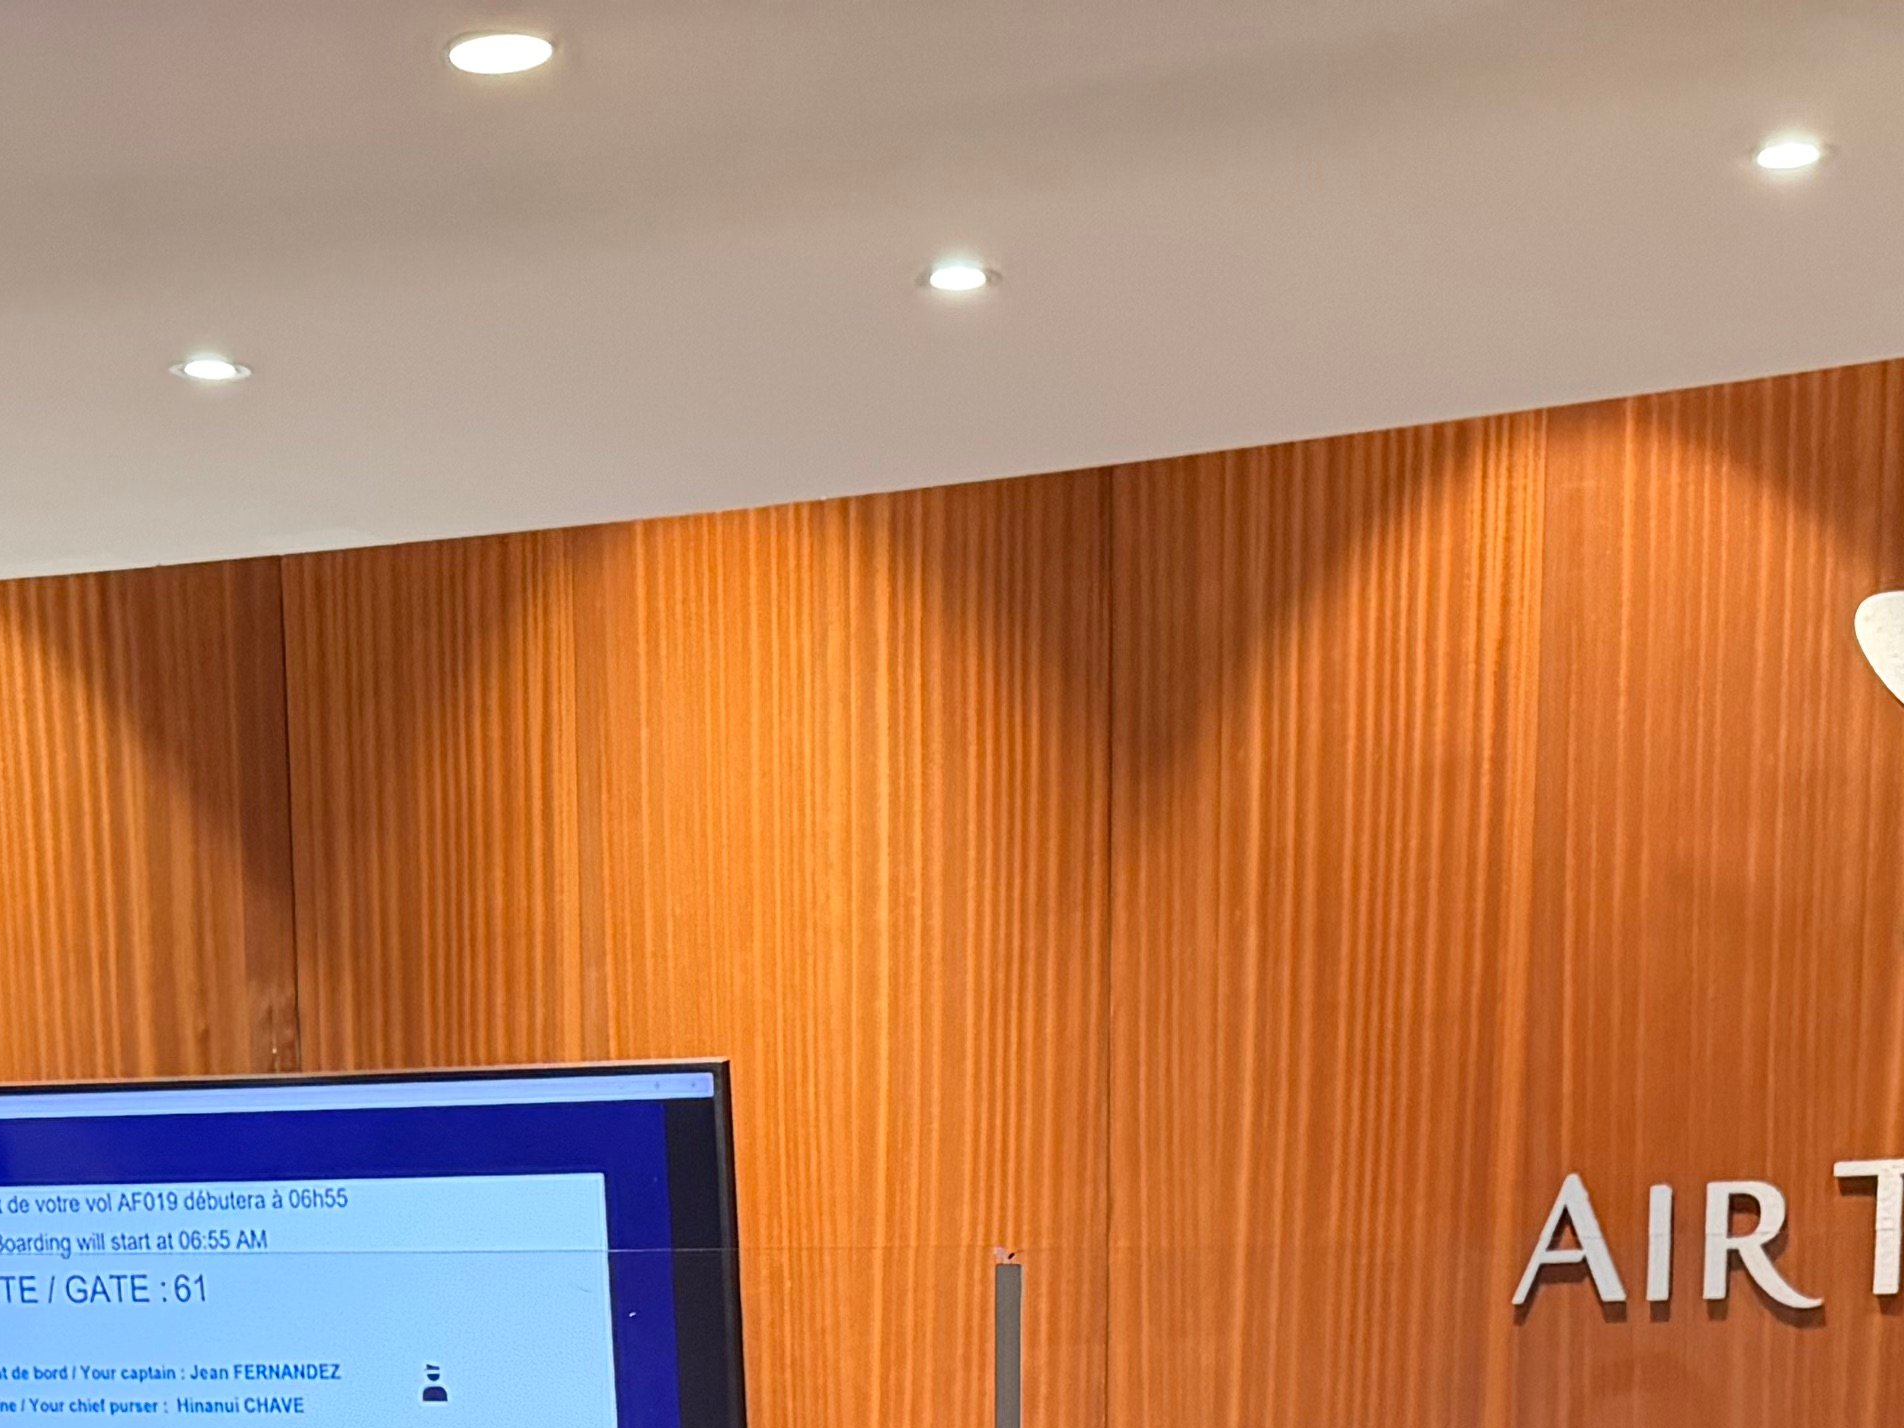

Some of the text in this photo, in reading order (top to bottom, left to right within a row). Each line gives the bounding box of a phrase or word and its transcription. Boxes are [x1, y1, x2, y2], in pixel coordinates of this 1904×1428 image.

[7, 1195, 30, 1215] de
[35, 1195, 80, 1214] votre
[86, 1194, 113, 1213] vol
[117, 1191, 177, 1212] AF019
[184, 1189, 265, 1211] débutera
[273, 1189, 284, 1210] à
[290, 1188, 348, 1209] 06h55
[77, 1232, 105, 1252] will
[111, 1233, 151, 1251] start
[156, 1233, 173, 1250] at
[179, 1230, 229, 1250] 06:55
[236, 1229, 268, 1250] AM
[1511, 1170, 1824, 1310] AIR
[48, 1275, 56, 1304] /
[65, 1274, 150, 1303] GATE
[174, 1274, 207, 1303] 61
[13, 1365, 29, 1380] de
[34, 1365, 68, 1380] bord
[81, 1365, 117, 1380] Your
[121, 1365, 176, 1383] captain
[190, 1365, 229, 1380] Jean
[234, 1364, 341, 1380] FERNANDEZ
[29, 1398, 65, 1414] Your
[69, 1398, 105, 1414] chief
[110, 1400, 157, 1417] purser
[177, 1398, 239, 1414] Hinanui
[244, 1397, 303, 1415] CHAVE
